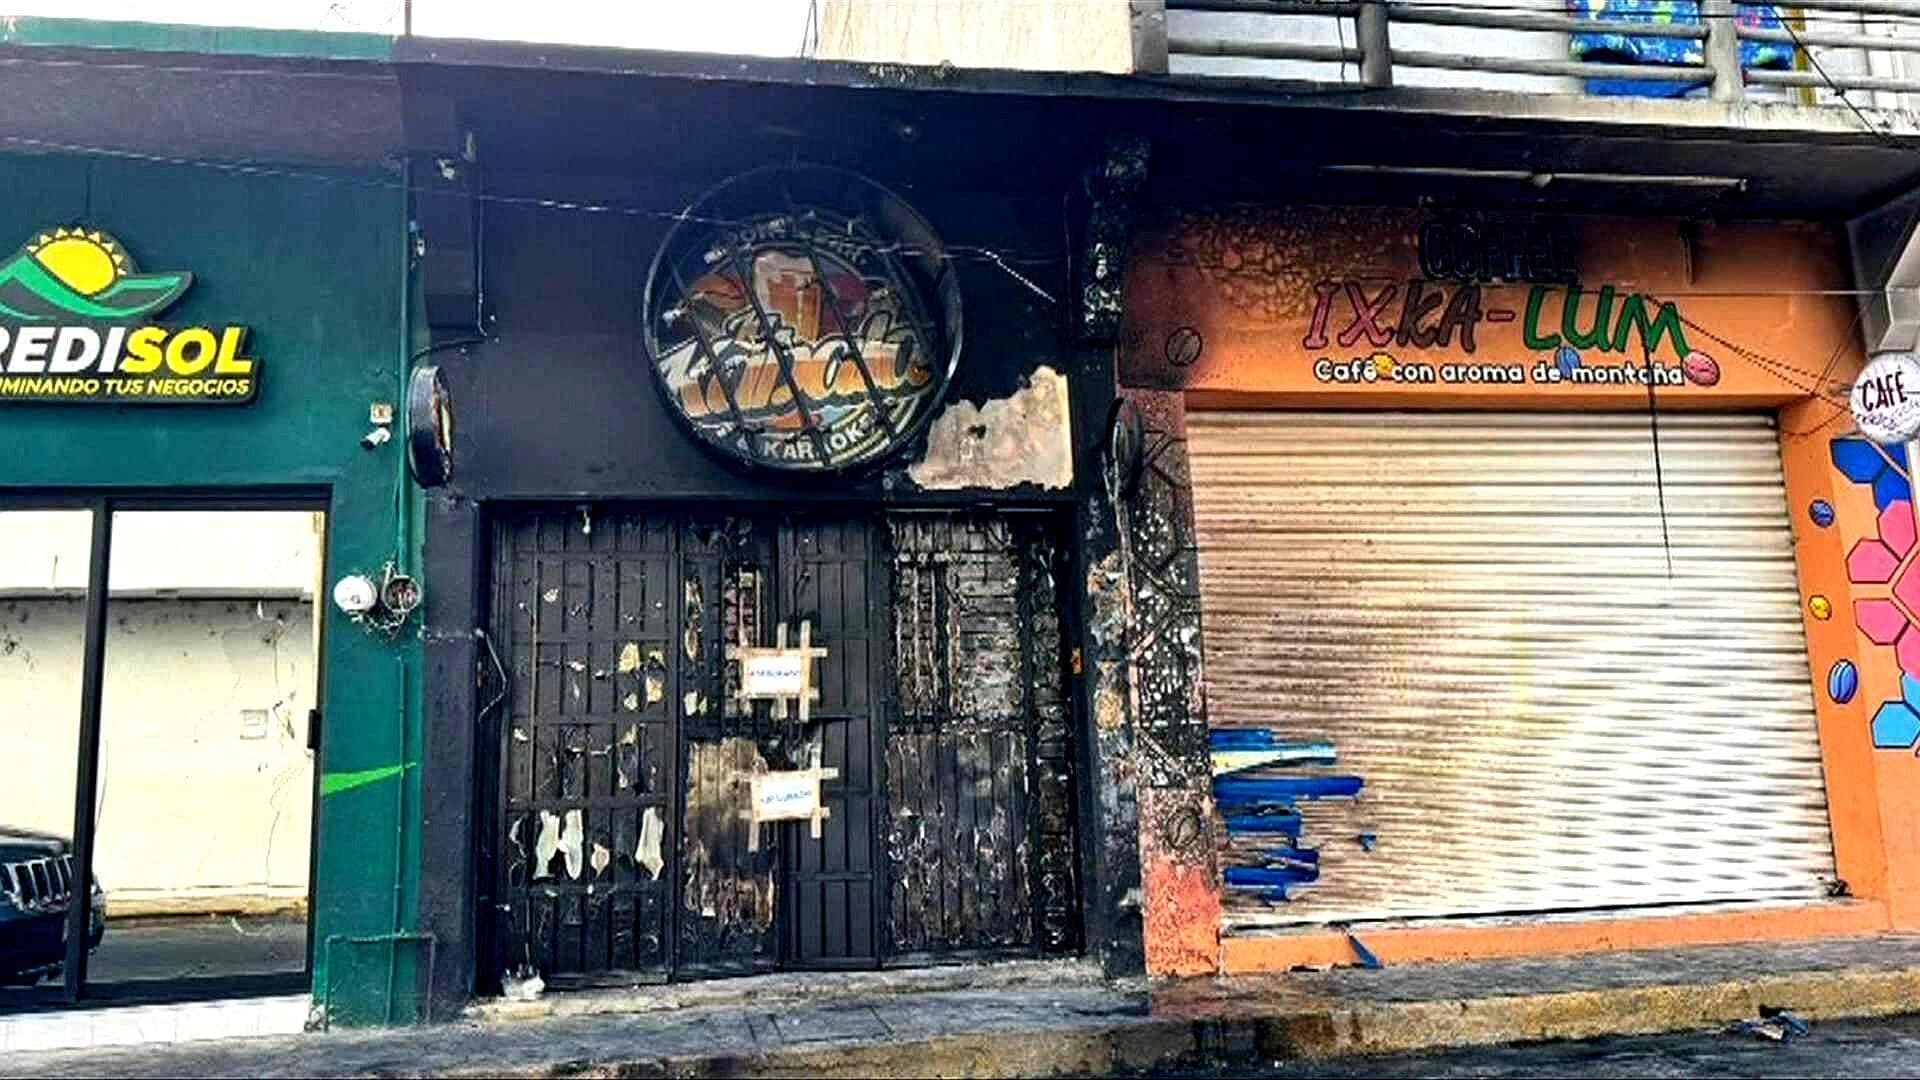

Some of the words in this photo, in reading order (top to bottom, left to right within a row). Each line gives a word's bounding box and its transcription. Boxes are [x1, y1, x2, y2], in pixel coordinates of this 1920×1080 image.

[1392, 363, 1434, 381] con
[1440, 364, 1524, 382] aroma
[1533, 362, 1561, 381] de
[1571, 363, 1684, 383] montaña
[0, 378, 99, 395] MINANDO
[104, 378, 144, 395] TUS
[148, 379, 250, 396] NEGOCIOS
